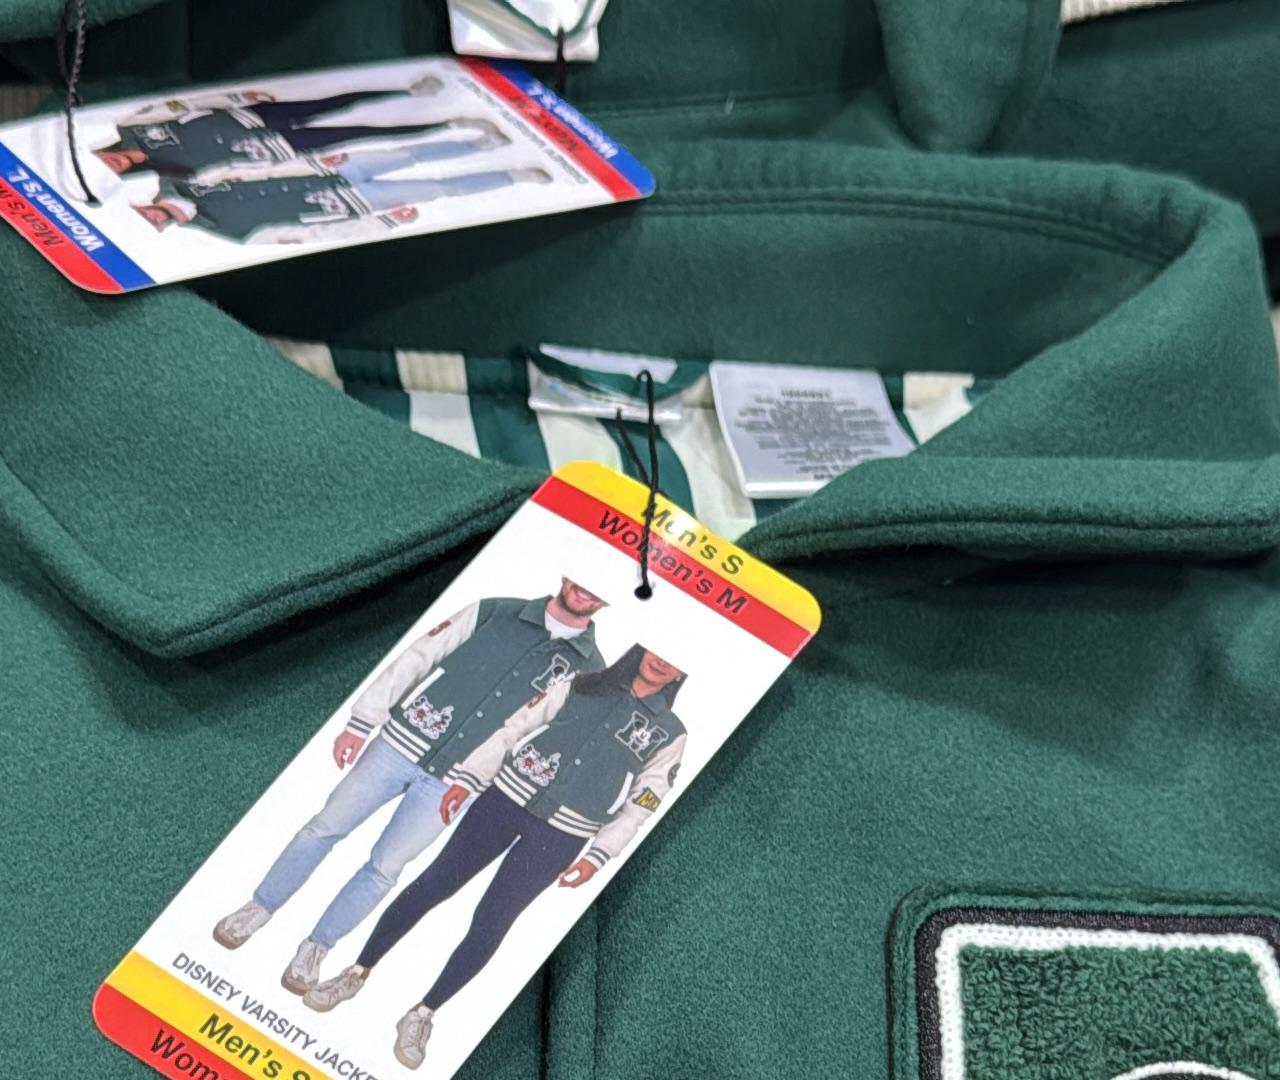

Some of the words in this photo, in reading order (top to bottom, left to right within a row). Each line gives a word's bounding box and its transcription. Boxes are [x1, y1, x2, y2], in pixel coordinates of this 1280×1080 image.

[7, 165, 26, 183] L
[7, 200, 64, 246] Men's
[22, 177, 105, 252] Women's
[721, 554, 744, 575] S
[716, 588, 748, 614] M
[172, 953, 241, 1002] DISNEY
[239, 994, 318, 1052] VARSITY
[198, 1013, 283, 1080] Men's
